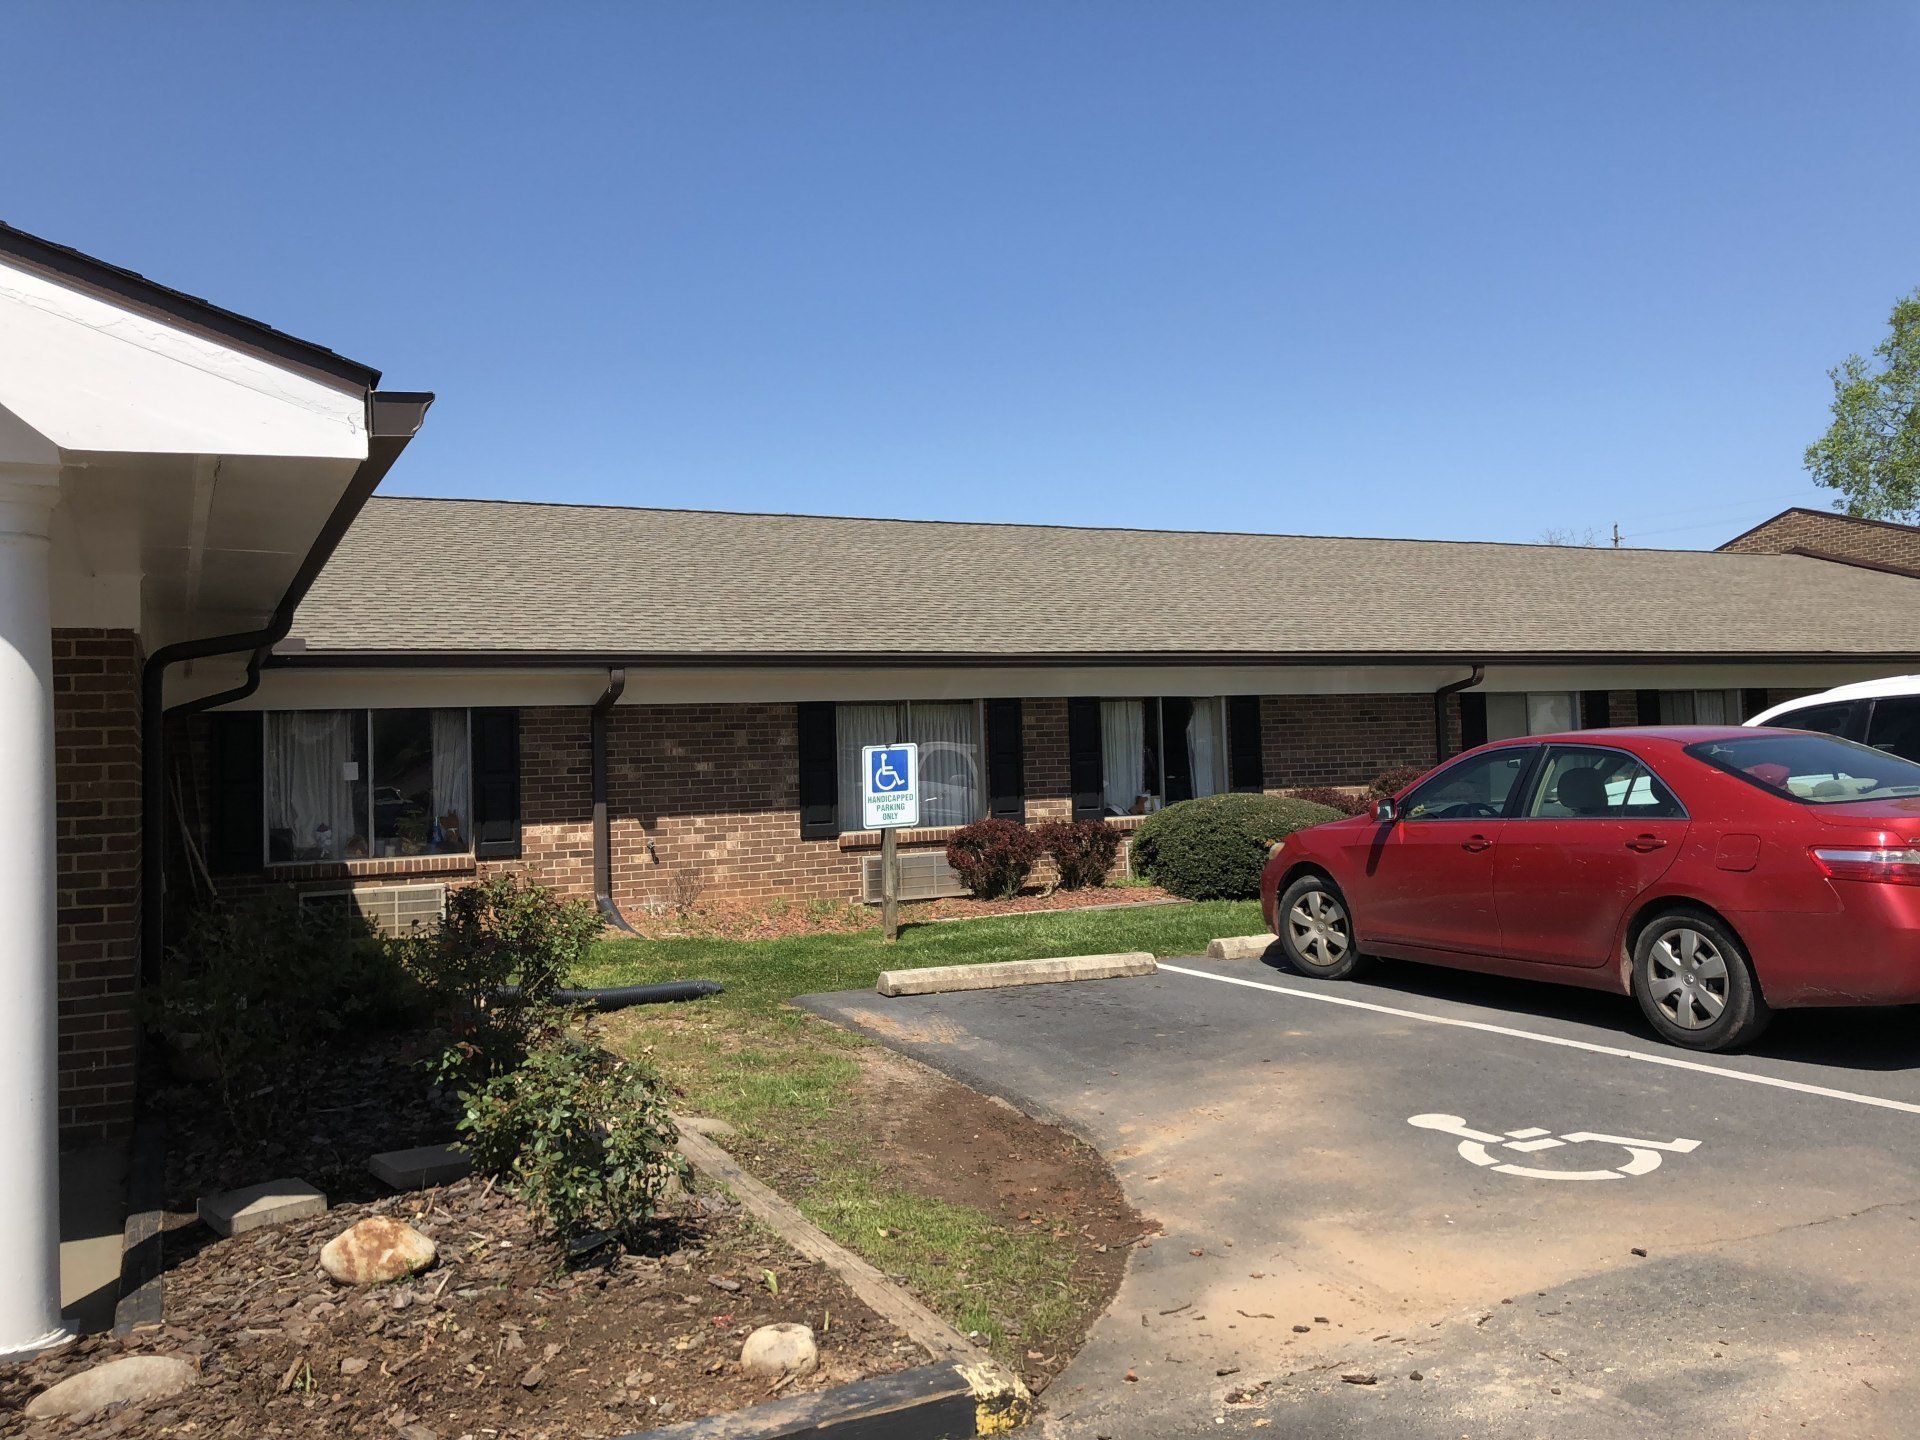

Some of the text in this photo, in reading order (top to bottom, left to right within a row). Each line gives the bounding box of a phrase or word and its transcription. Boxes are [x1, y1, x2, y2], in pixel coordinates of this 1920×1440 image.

[867, 794, 914, 804] HANDICAPPED
[876, 803, 906, 812] PARKING
[882, 812, 898, 821] ONLY
